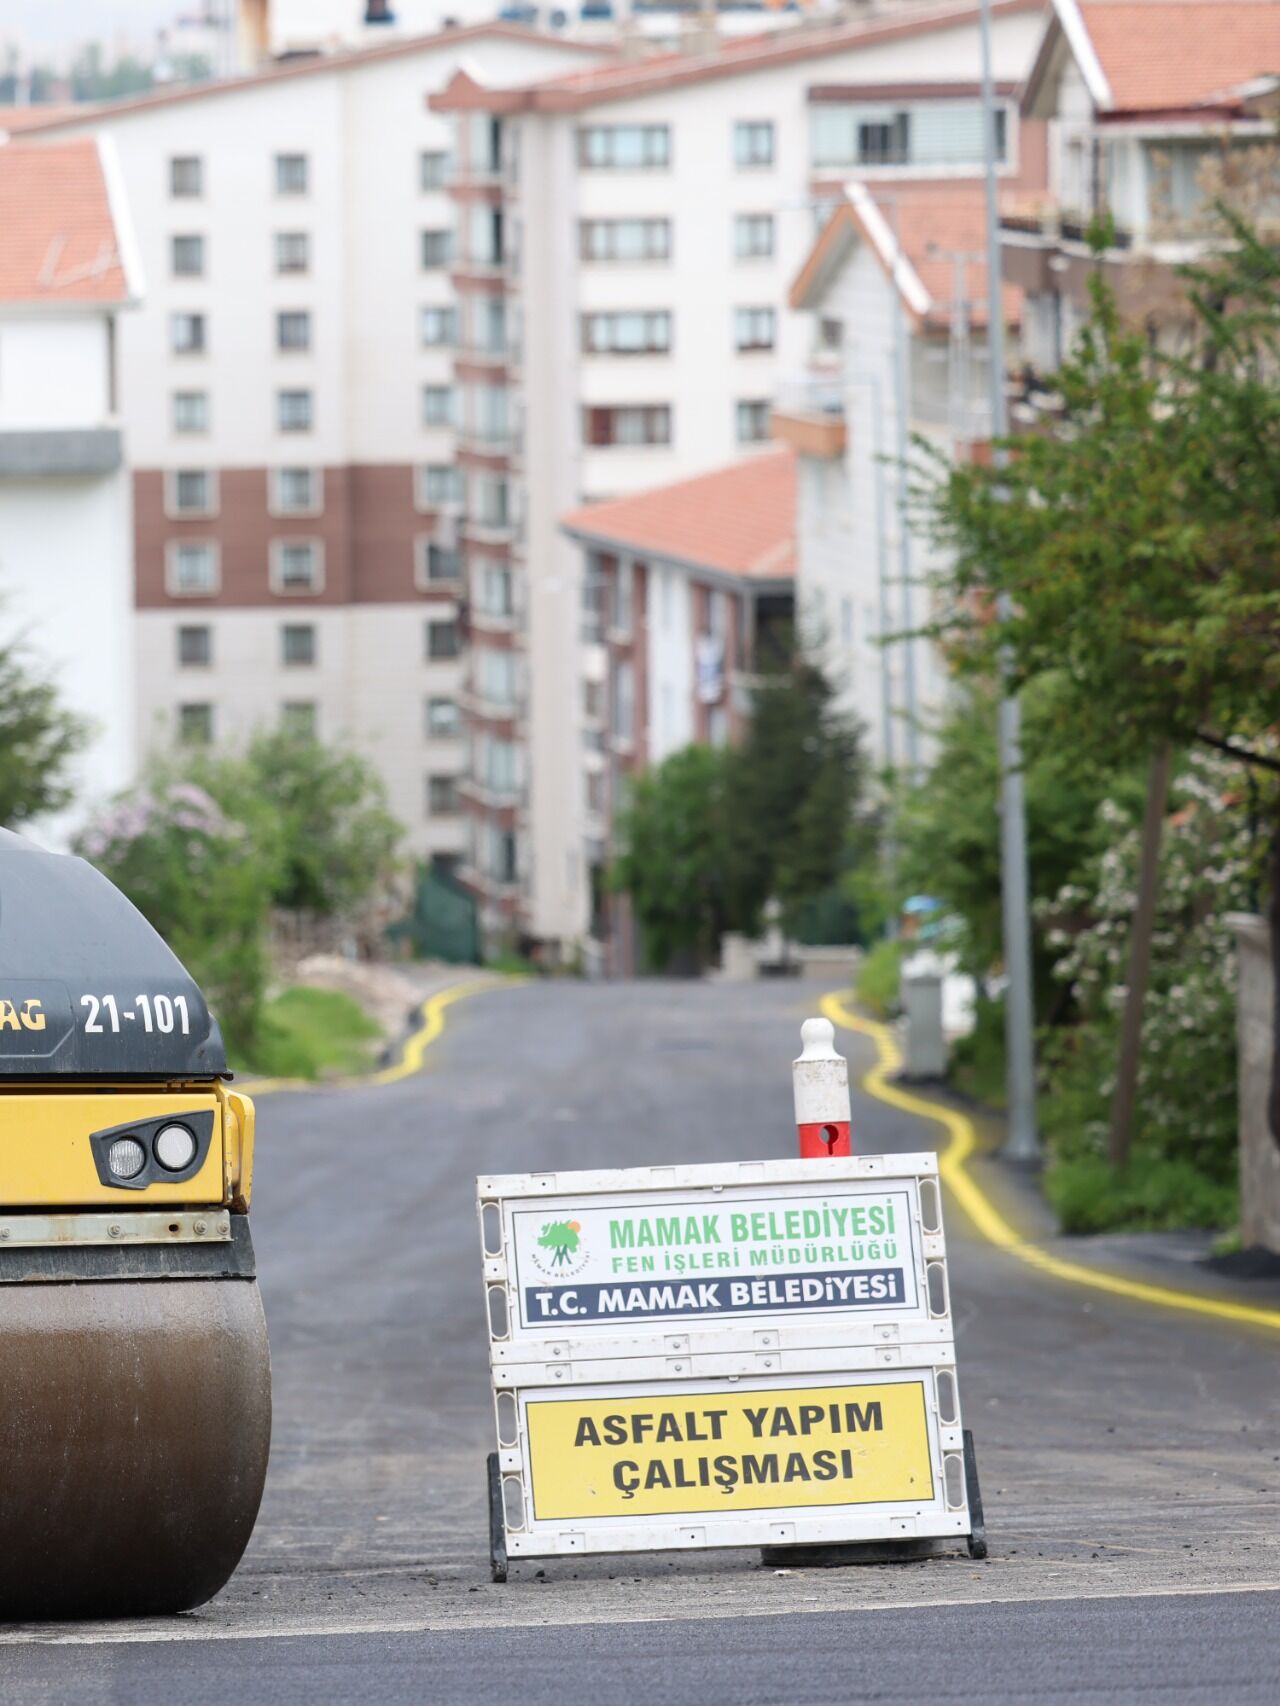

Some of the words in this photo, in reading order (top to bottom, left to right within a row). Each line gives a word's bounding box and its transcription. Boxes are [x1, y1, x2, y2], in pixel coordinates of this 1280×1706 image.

[80, 994, 191, 1035] 21-101
[609, 1214, 722, 1249] MAMAK
[730, 1198, 896, 1243] BELEDİYESİ
[611, 1255, 655, 1274] FEN
[664, 1246, 740, 1276] İŞLERİ
[749, 1238, 898, 1267] MÜDÜRLÜĞÜ
[535, 1291, 588, 1317] T.C.
[597, 1283, 722, 1314] MAMAK
[574, 1409, 728, 1447] ASFALT
[741, 1401, 884, 1438] YAPIM
[612, 1449, 854, 1500] ÇALIŞMASI
